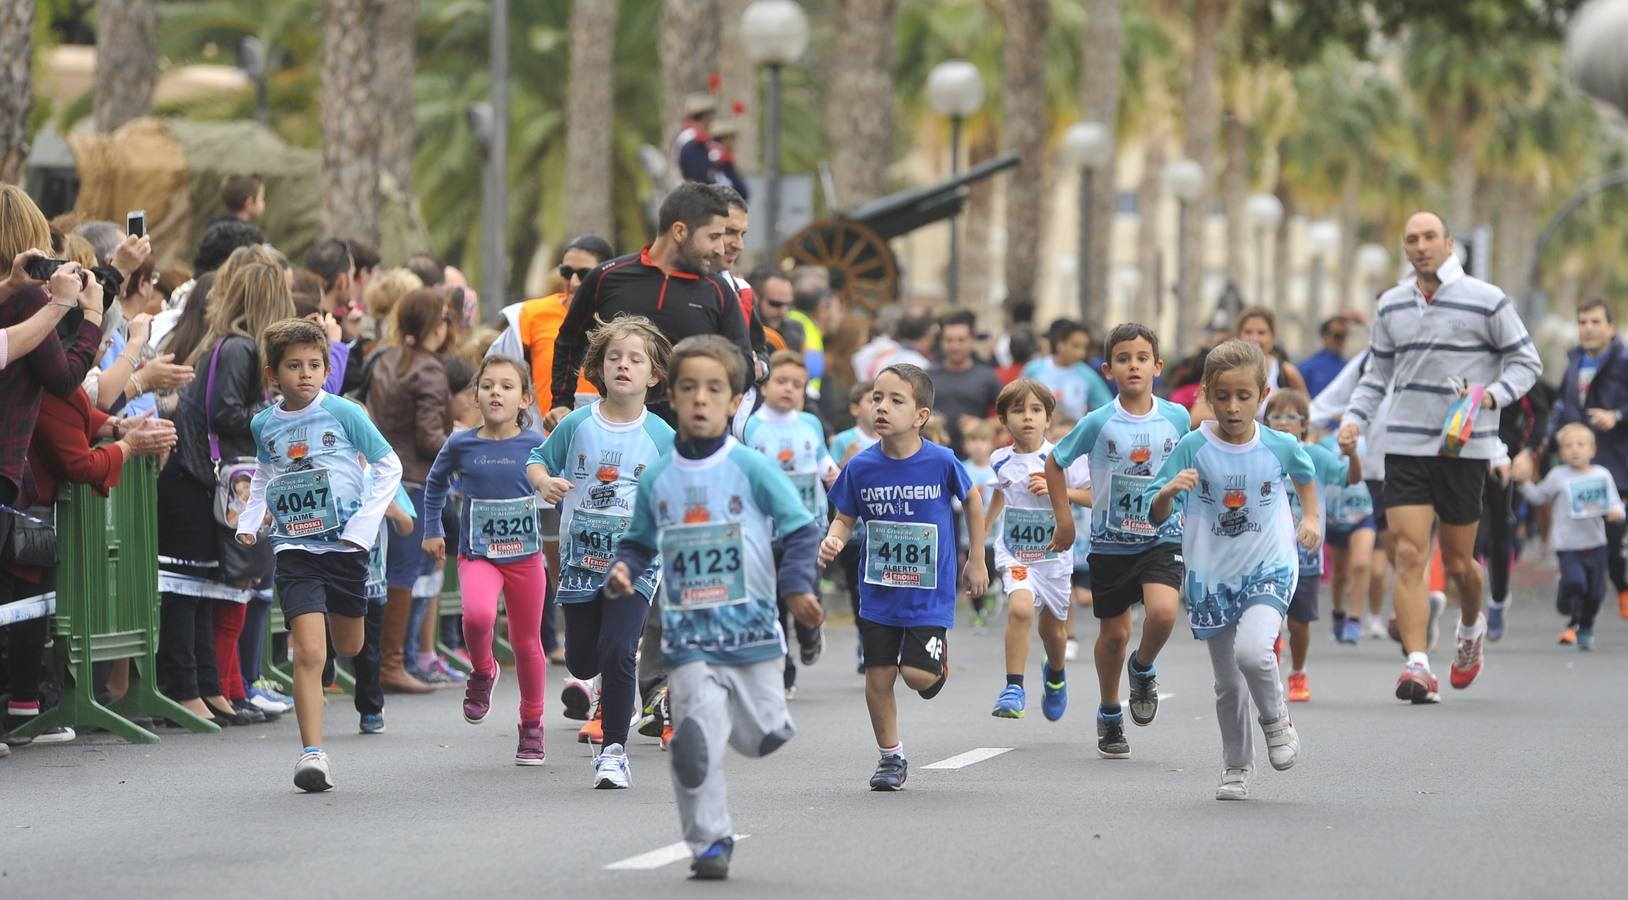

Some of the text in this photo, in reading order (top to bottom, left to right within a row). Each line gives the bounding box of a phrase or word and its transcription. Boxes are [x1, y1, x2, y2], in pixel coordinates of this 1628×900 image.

[276, 487, 329, 514] 4047
[860, 483, 941, 502] CARTAGENA
[1118, 493, 1147, 514] 41
[287, 512, 315, 523] JAIME
[294, 520, 321, 531] EROSKI
[482, 515, 534, 537] 4320
[580, 529, 624, 552] 401
[1010, 524, 1056, 543] 4401
[498, 543, 521, 551] EROSKI
[583, 549, 614, 560] ANDREA
[879, 542, 931, 565] 4181
[671, 546, 741, 578] 4123
[883, 564, 918, 573] ALBERTO
[892, 573, 918, 581] EROSKI
[925, 636, 943, 661] 42
